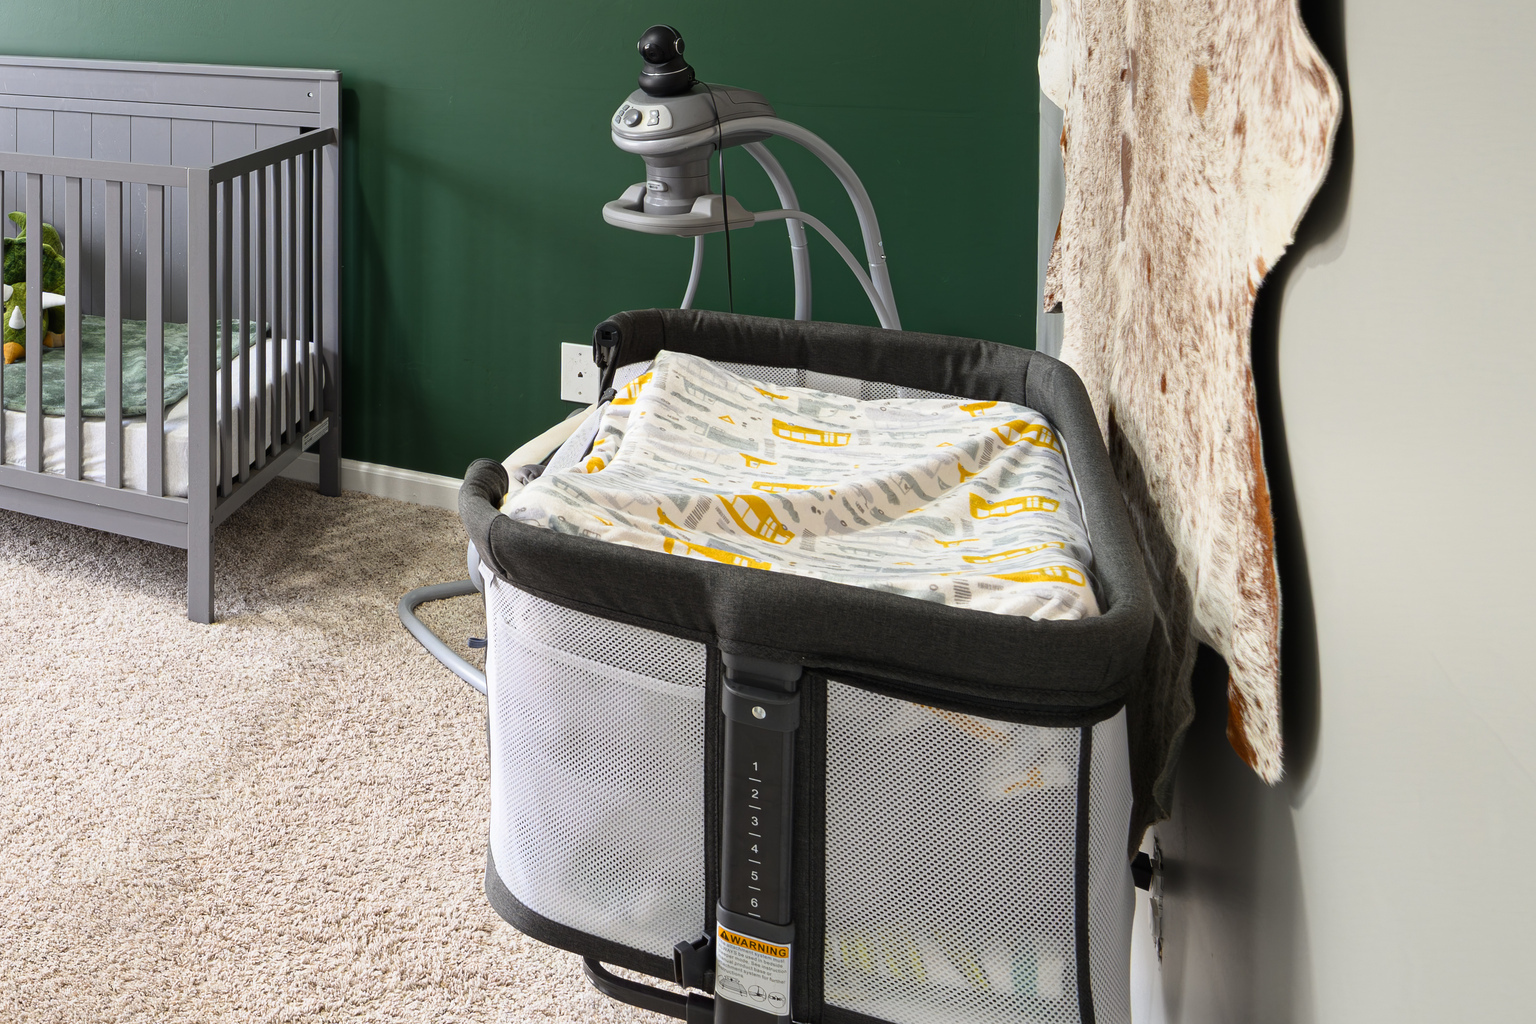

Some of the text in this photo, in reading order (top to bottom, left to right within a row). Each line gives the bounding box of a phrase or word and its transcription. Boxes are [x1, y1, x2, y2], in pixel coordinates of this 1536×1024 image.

[752, 761, 758, 772] 1
[751, 788, 759, 799] 2
[751, 816, 759, 826] 3
[750, 844, 759, 854] 4
[751, 870, 759, 881] 5
[750, 897, 759, 908] 6
[730, 934, 787, 957] WARNING
